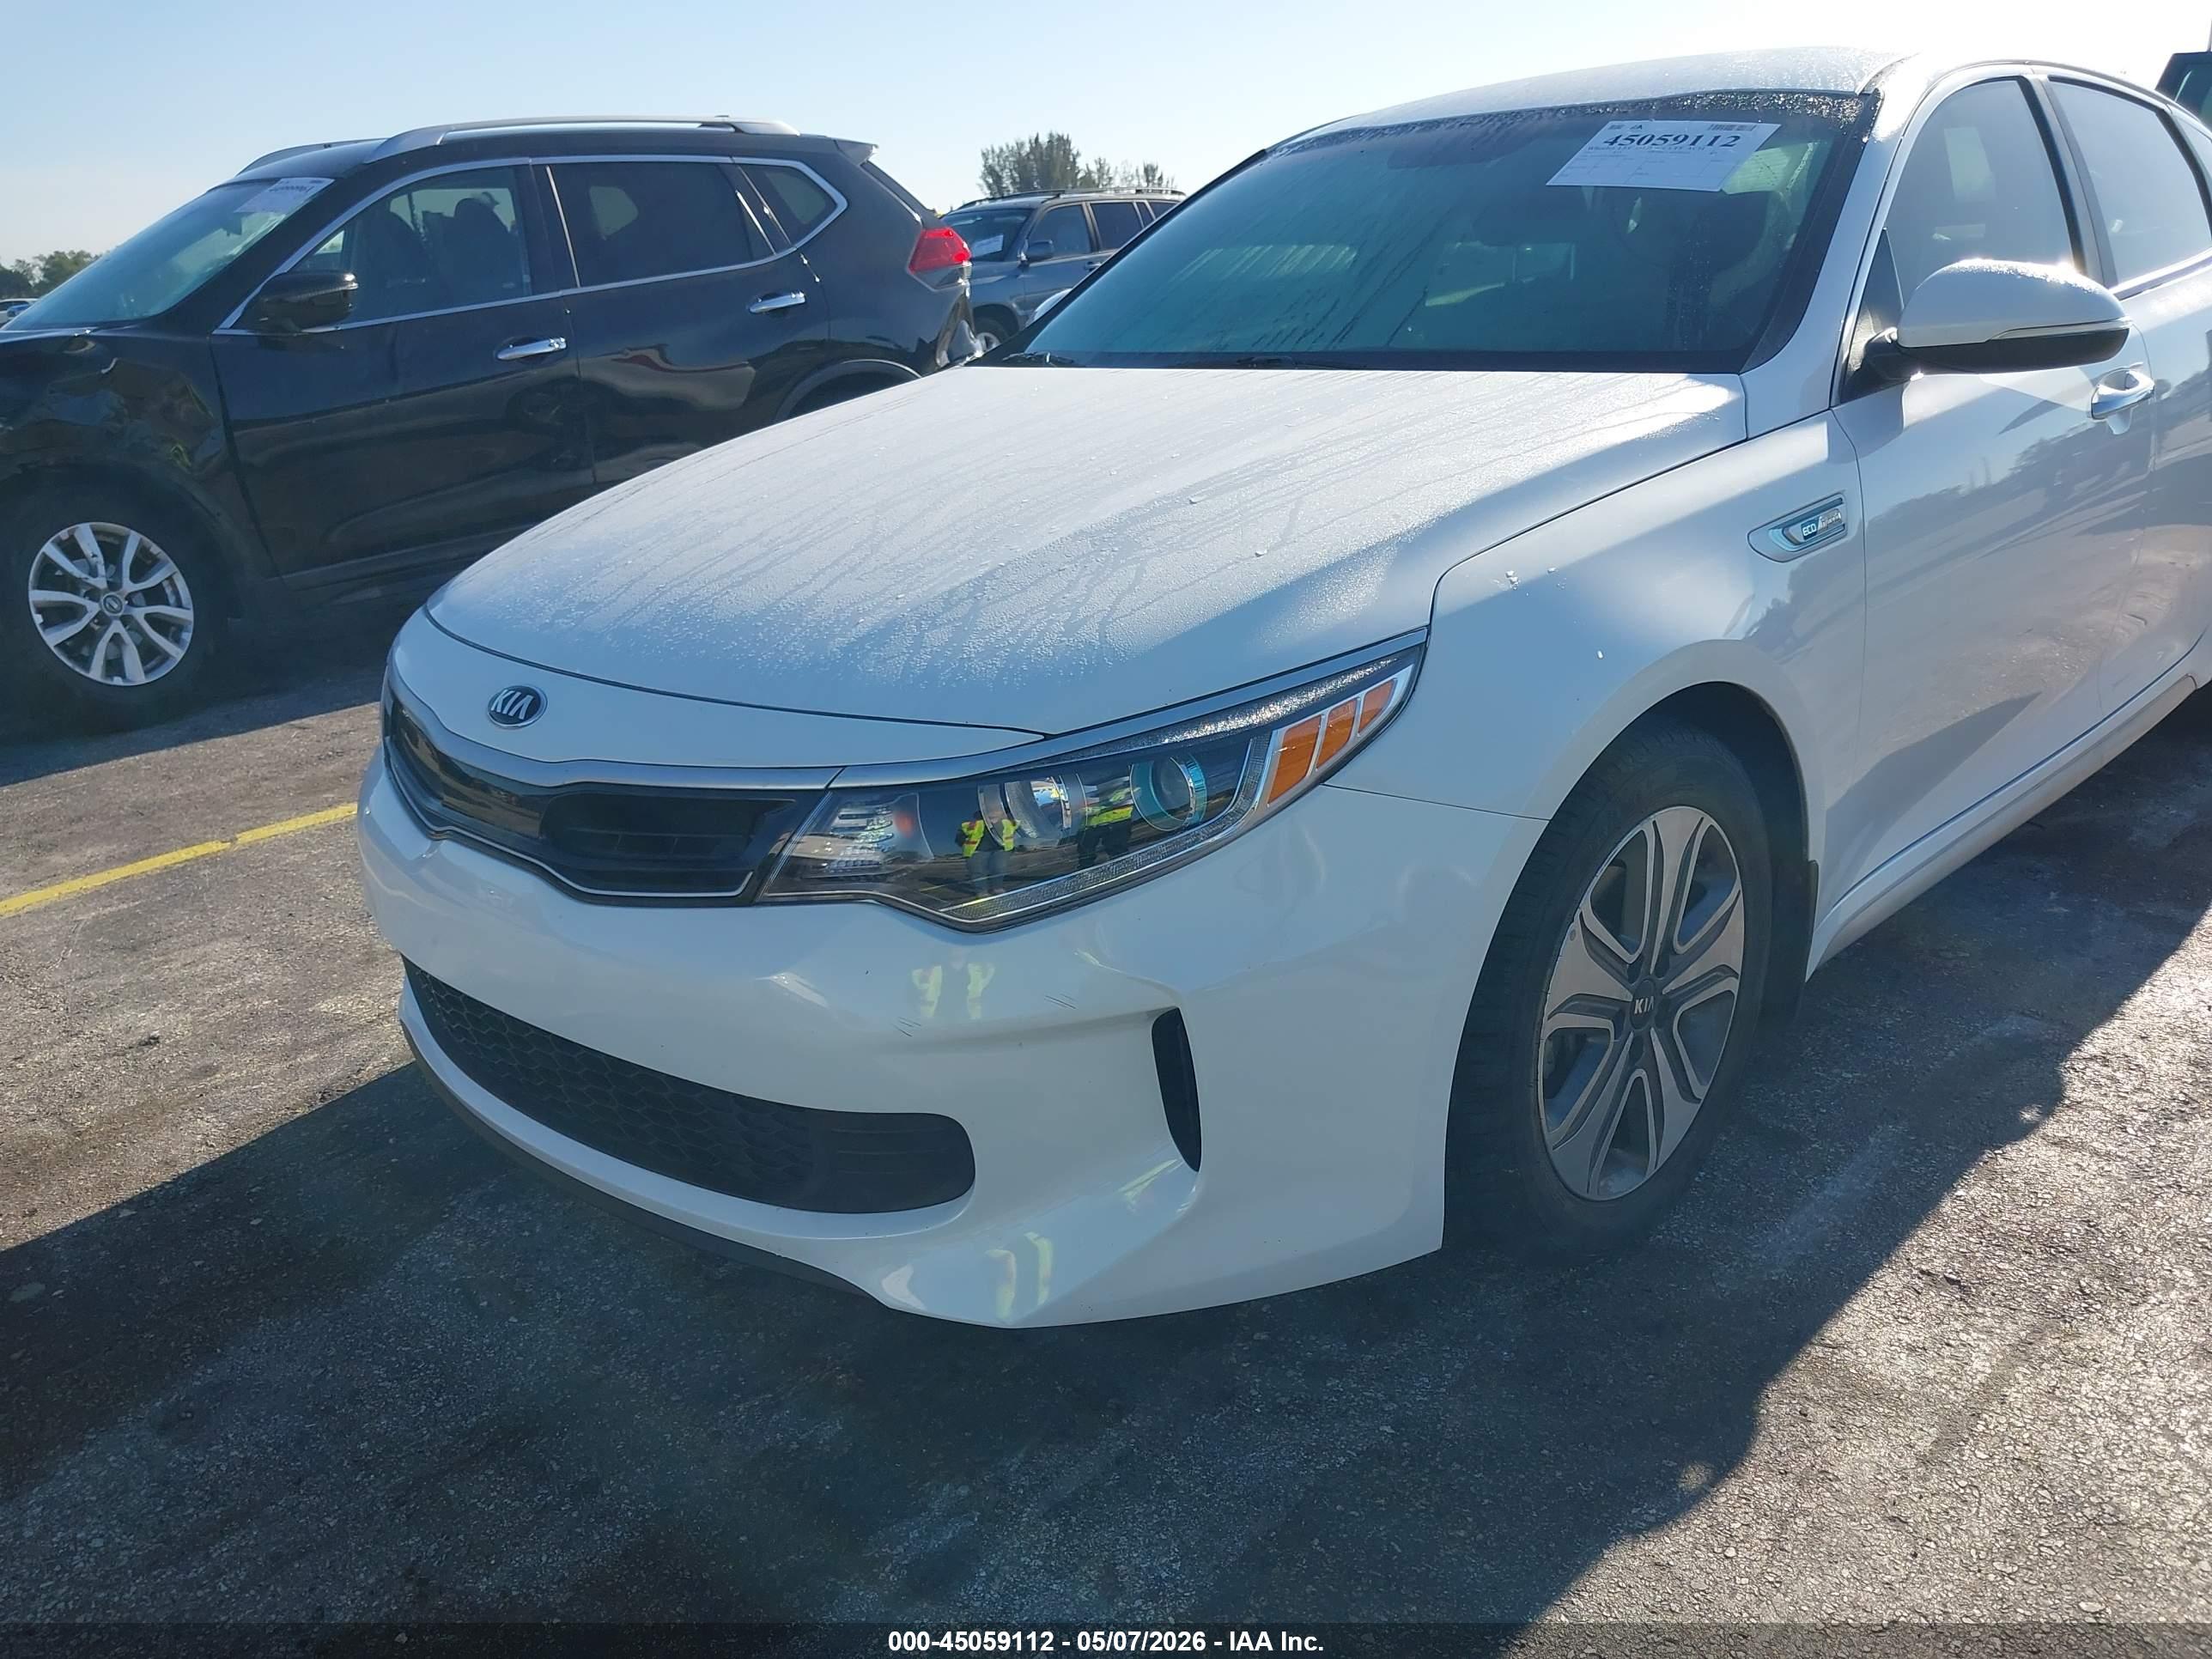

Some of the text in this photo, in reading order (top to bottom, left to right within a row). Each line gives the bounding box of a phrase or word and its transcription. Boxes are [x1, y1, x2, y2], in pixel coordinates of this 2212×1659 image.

[1603, 133, 1741, 148] 45059112
[490, 689, 534, 720] KIA
[1634, 995, 1655, 1014] KIA
